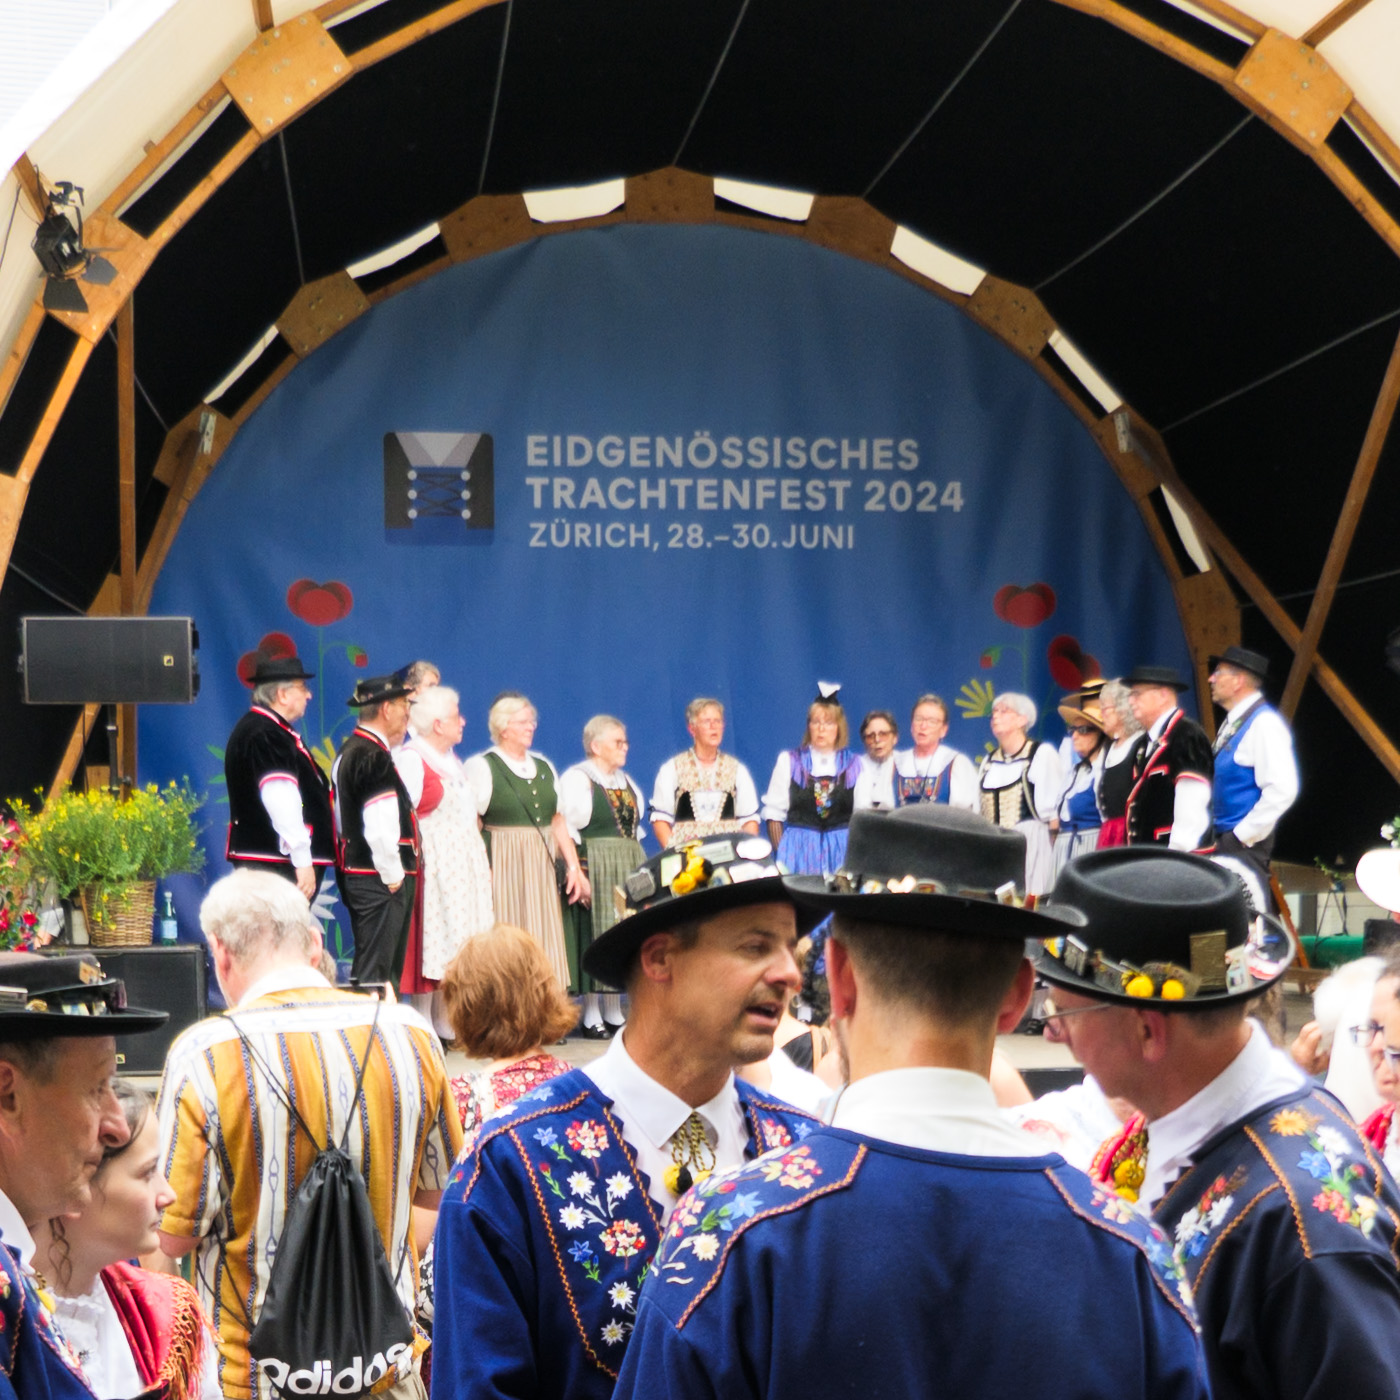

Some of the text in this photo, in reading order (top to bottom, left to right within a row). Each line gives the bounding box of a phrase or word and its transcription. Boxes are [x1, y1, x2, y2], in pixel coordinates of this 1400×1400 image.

[525, 430, 919, 470] EIDGENÖSSISCHES
[525, 476, 964, 513] TRACHTENFEST 2024
[529, 517, 659, 552] ZÜRICH,
[257, 1342, 410, 1395] adidas
